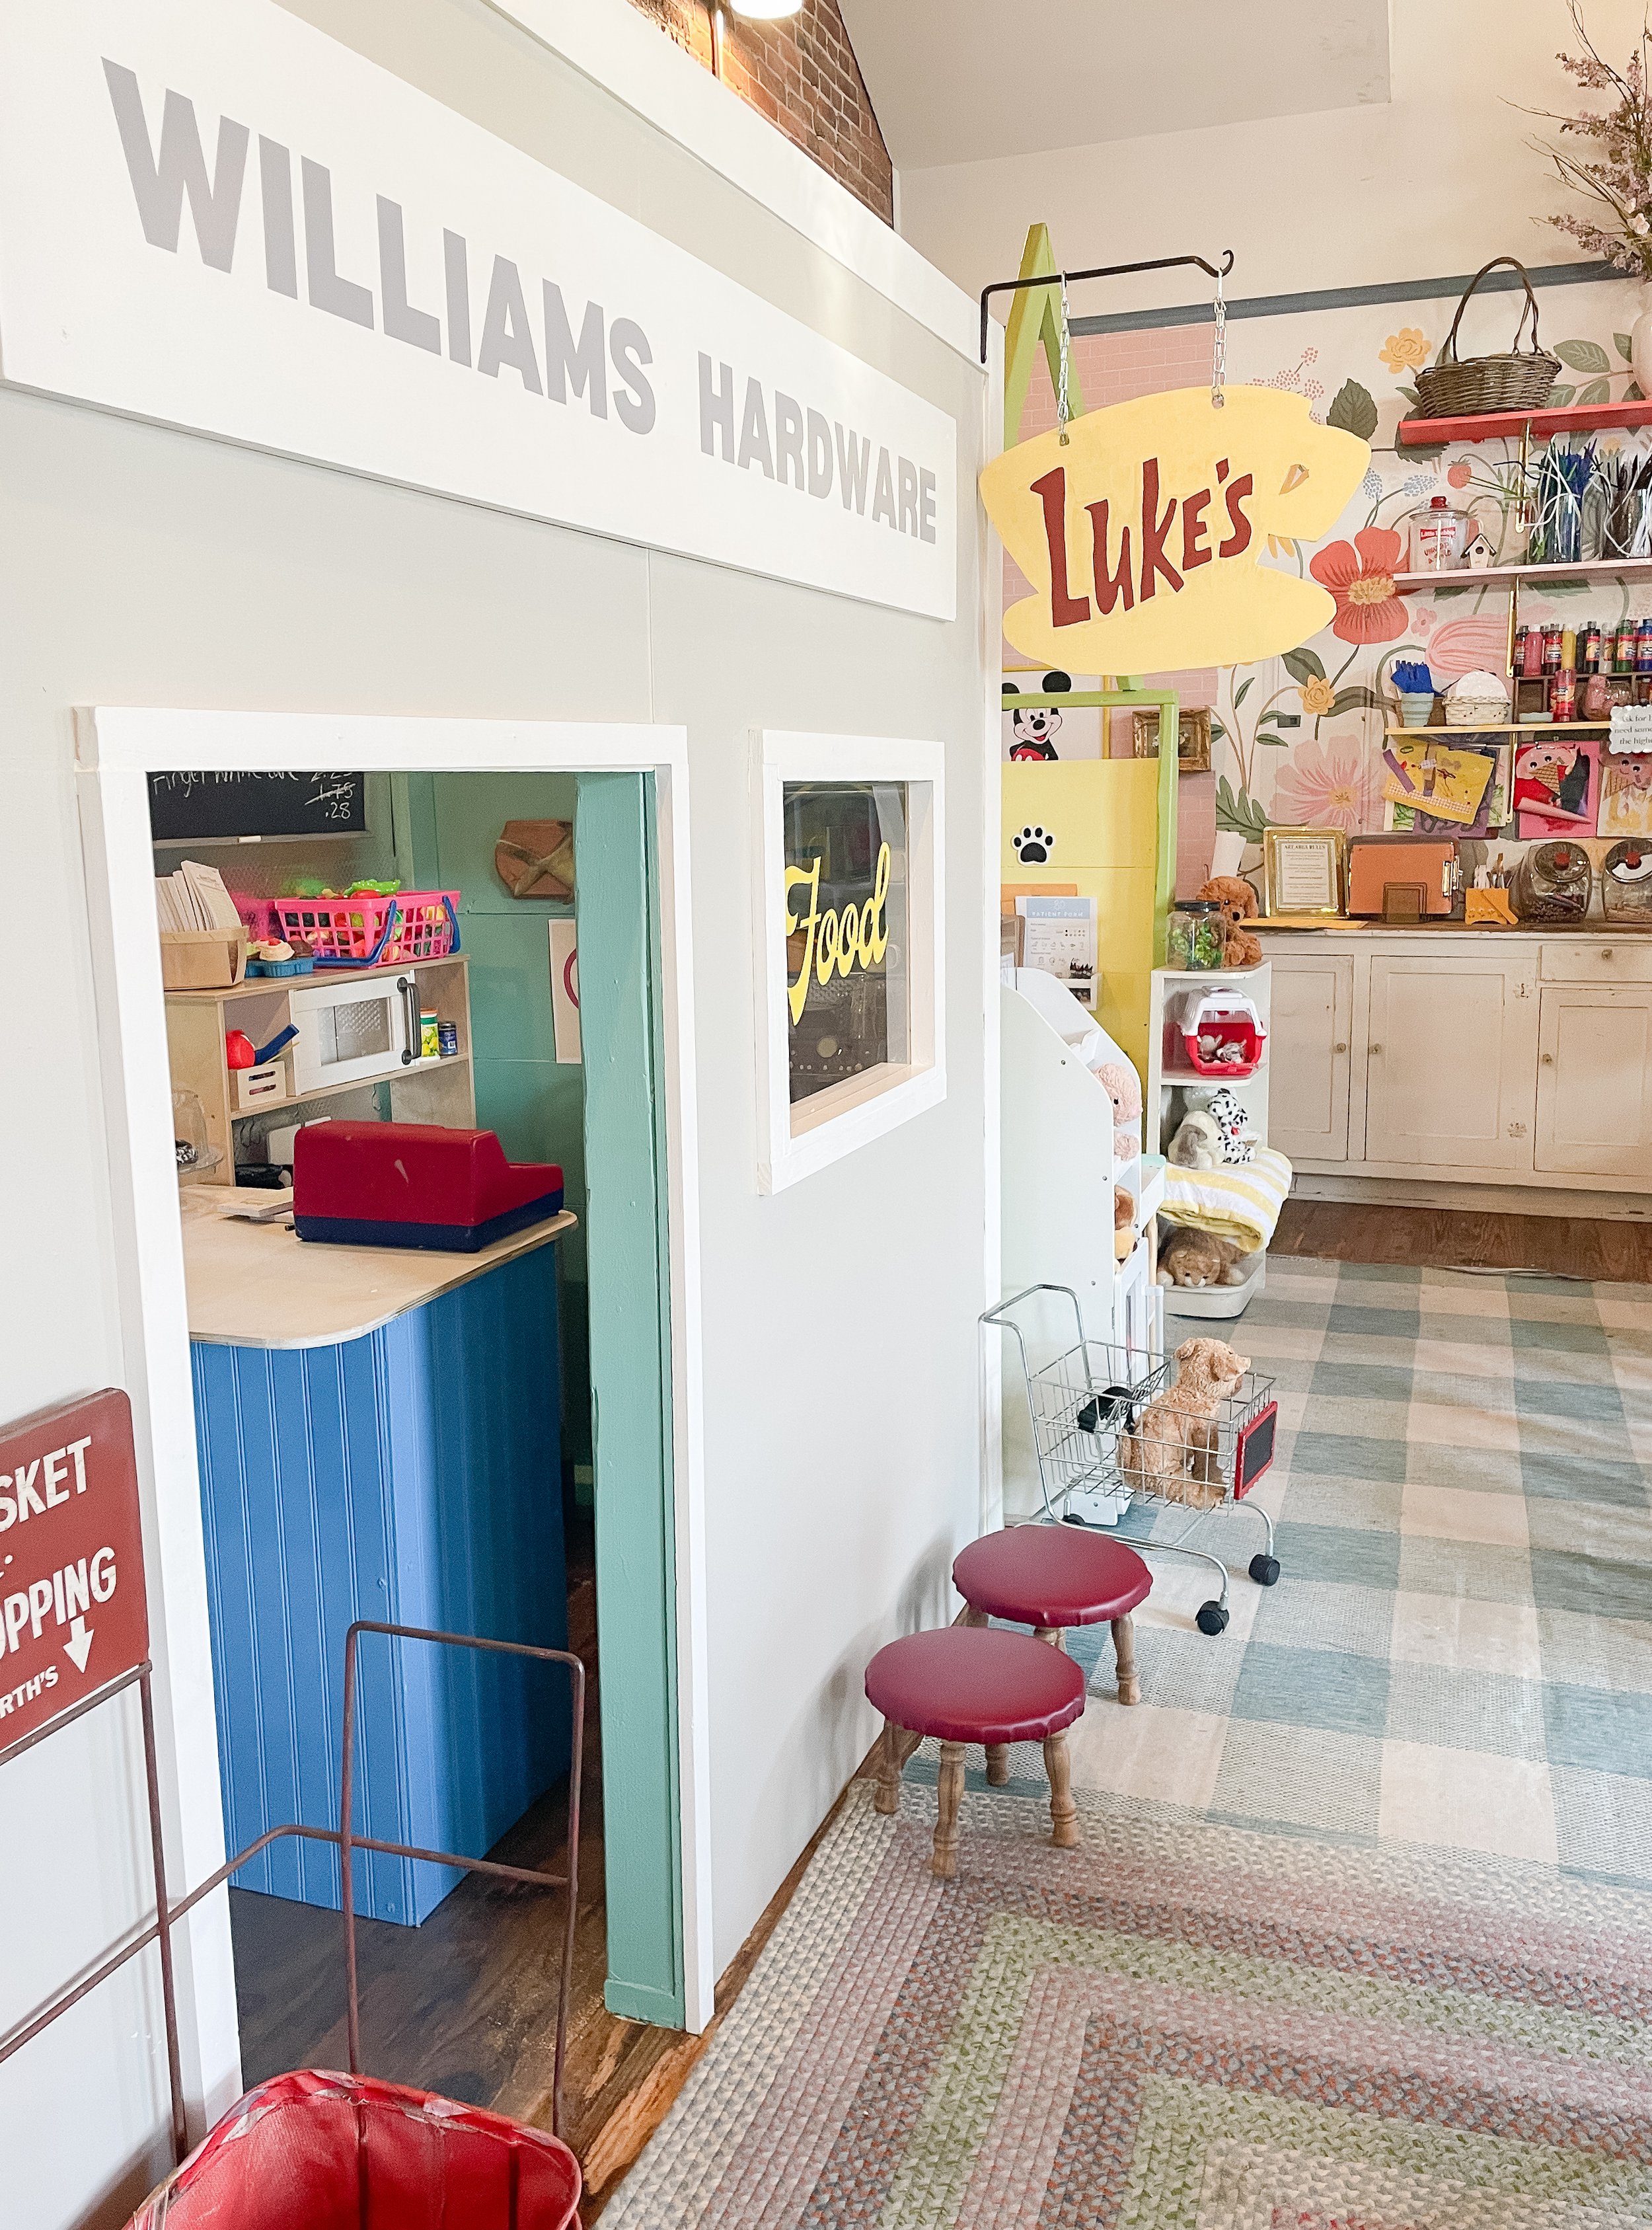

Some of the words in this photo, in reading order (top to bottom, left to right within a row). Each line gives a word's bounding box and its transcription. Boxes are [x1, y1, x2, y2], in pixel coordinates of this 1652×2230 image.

[101, 56, 656, 436] WILLIAMS
[698, 351, 936, 544] HARDWARE
[325, 801, 352, 820] .28
[784, 841, 890, 1026] Food
[0, 1546, 117, 1661] PPING
